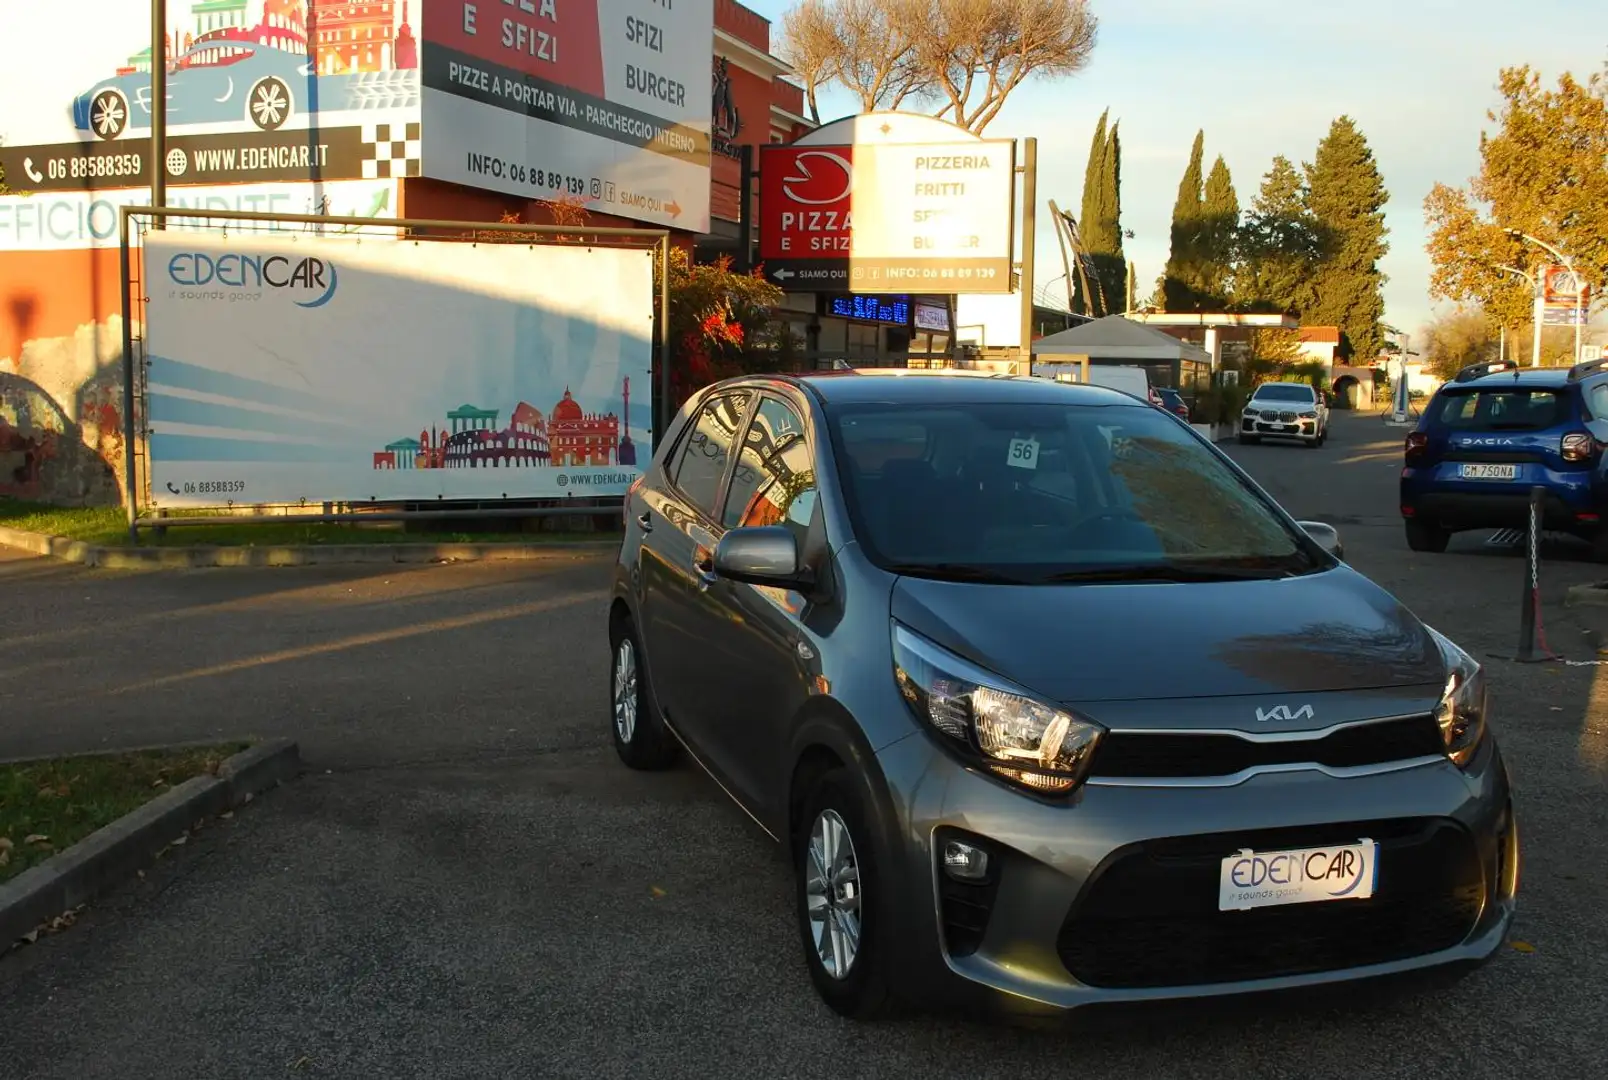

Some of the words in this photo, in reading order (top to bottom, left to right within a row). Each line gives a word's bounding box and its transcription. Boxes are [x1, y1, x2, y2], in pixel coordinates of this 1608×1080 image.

[464, 3, 477, 34] E
[502, 17, 557, 62] SFIZI
[625, 15, 663, 53] SFIZI
[626, 63, 685, 107] BURGER
[449, 61, 489, 92] PIZZE
[492, 76, 501, 96] A
[505, 78, 555, 112] PORTAR
[557, 94, 578, 119] VIA
[586, 104, 653, 141] PARCHEGGIO
[654, 126, 696, 154] INTERNO
[48, 158, 67, 179] 06
[70, 154, 142, 178] 88588359
[194, 144, 329, 172] WWW.EDENCAR.IT
[915, 156, 990, 170] PIZZERIA
[467, 152, 507, 180] INFO:
[510, 163, 527, 183] 06
[529, 170, 545, 187] 88
[548, 172, 563, 190] 89
[565, 176, 585, 195] 139
[914, 182, 965, 196] FRITTI
[620, 190, 647, 209] SIAMO
[647, 199, 662, 212] QUI
[781, 211, 856, 232] PIZZA
[781, 236, 792, 251] E
[168, 253, 326, 289] EDENCAR
[799, 270, 829, 279] SIAMO
[830, 270, 847, 279] QUI
[886, 267, 920, 279] INFO:
[923, 267, 938, 278] 06
[975, 267, 996, 279] 139
[179, 289, 225, 300] sounds
[1012, 442, 1033, 460] 56
[184, 482, 196, 494] 06
[199, 481, 245, 493] 88588359
[1255, 704, 1315, 722] KIA
[1231, 849, 1356, 888] EDENCAR
[1237, 889, 1273, 901] sounds
